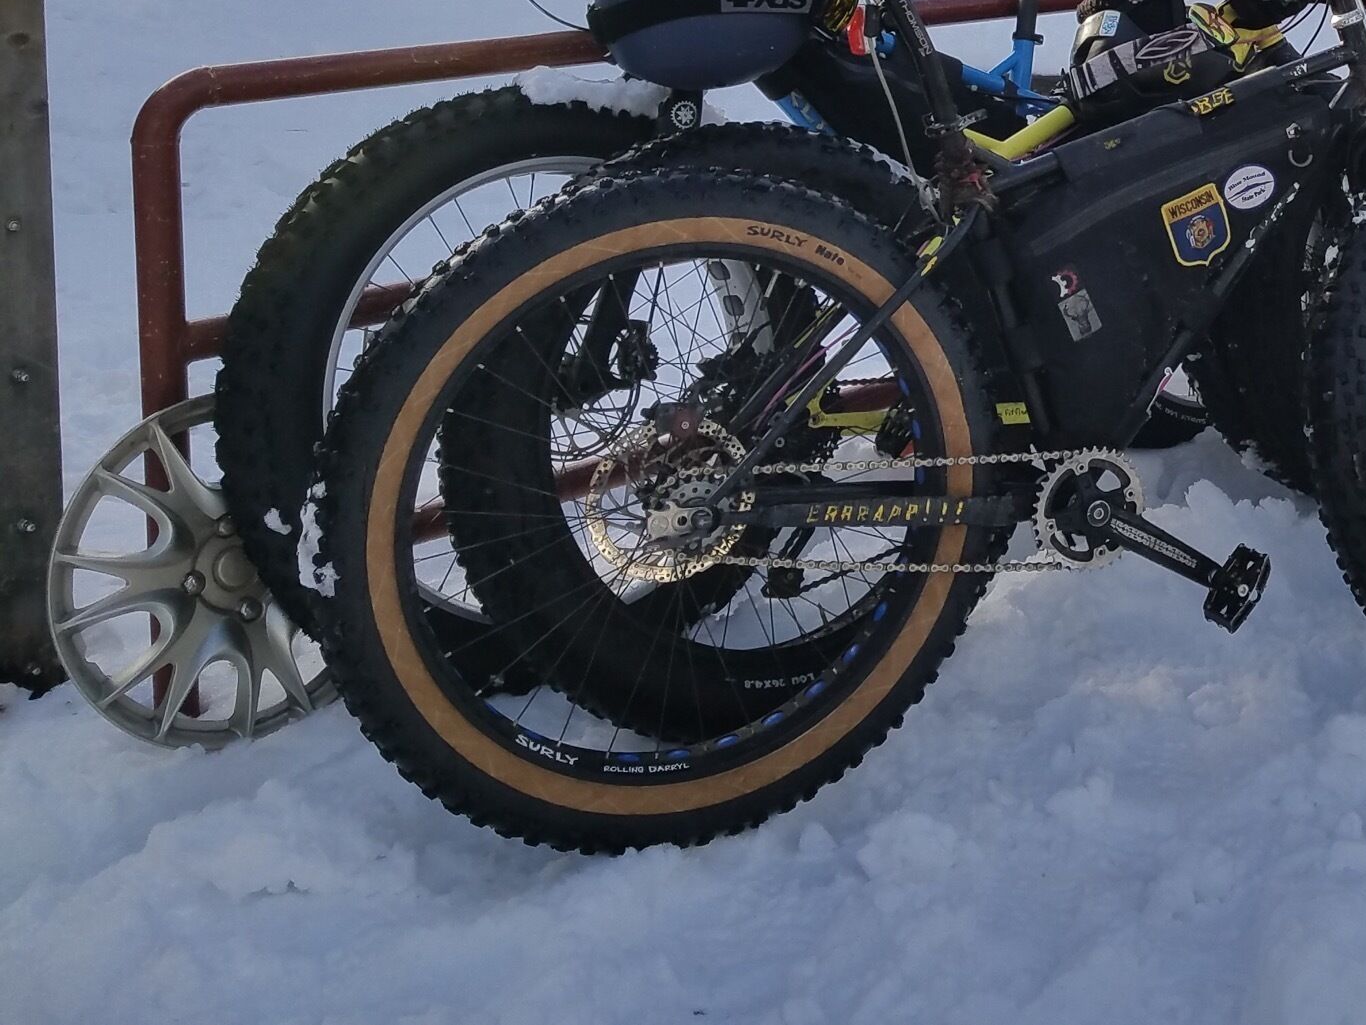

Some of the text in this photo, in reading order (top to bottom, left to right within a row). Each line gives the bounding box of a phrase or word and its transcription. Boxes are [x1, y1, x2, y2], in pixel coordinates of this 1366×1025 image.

[1167, 189, 1215, 219] WISCONSIN
[746, 225, 808, 248] SURLY
[515, 734, 691, 774] SURLY ROLLING DARRYL
